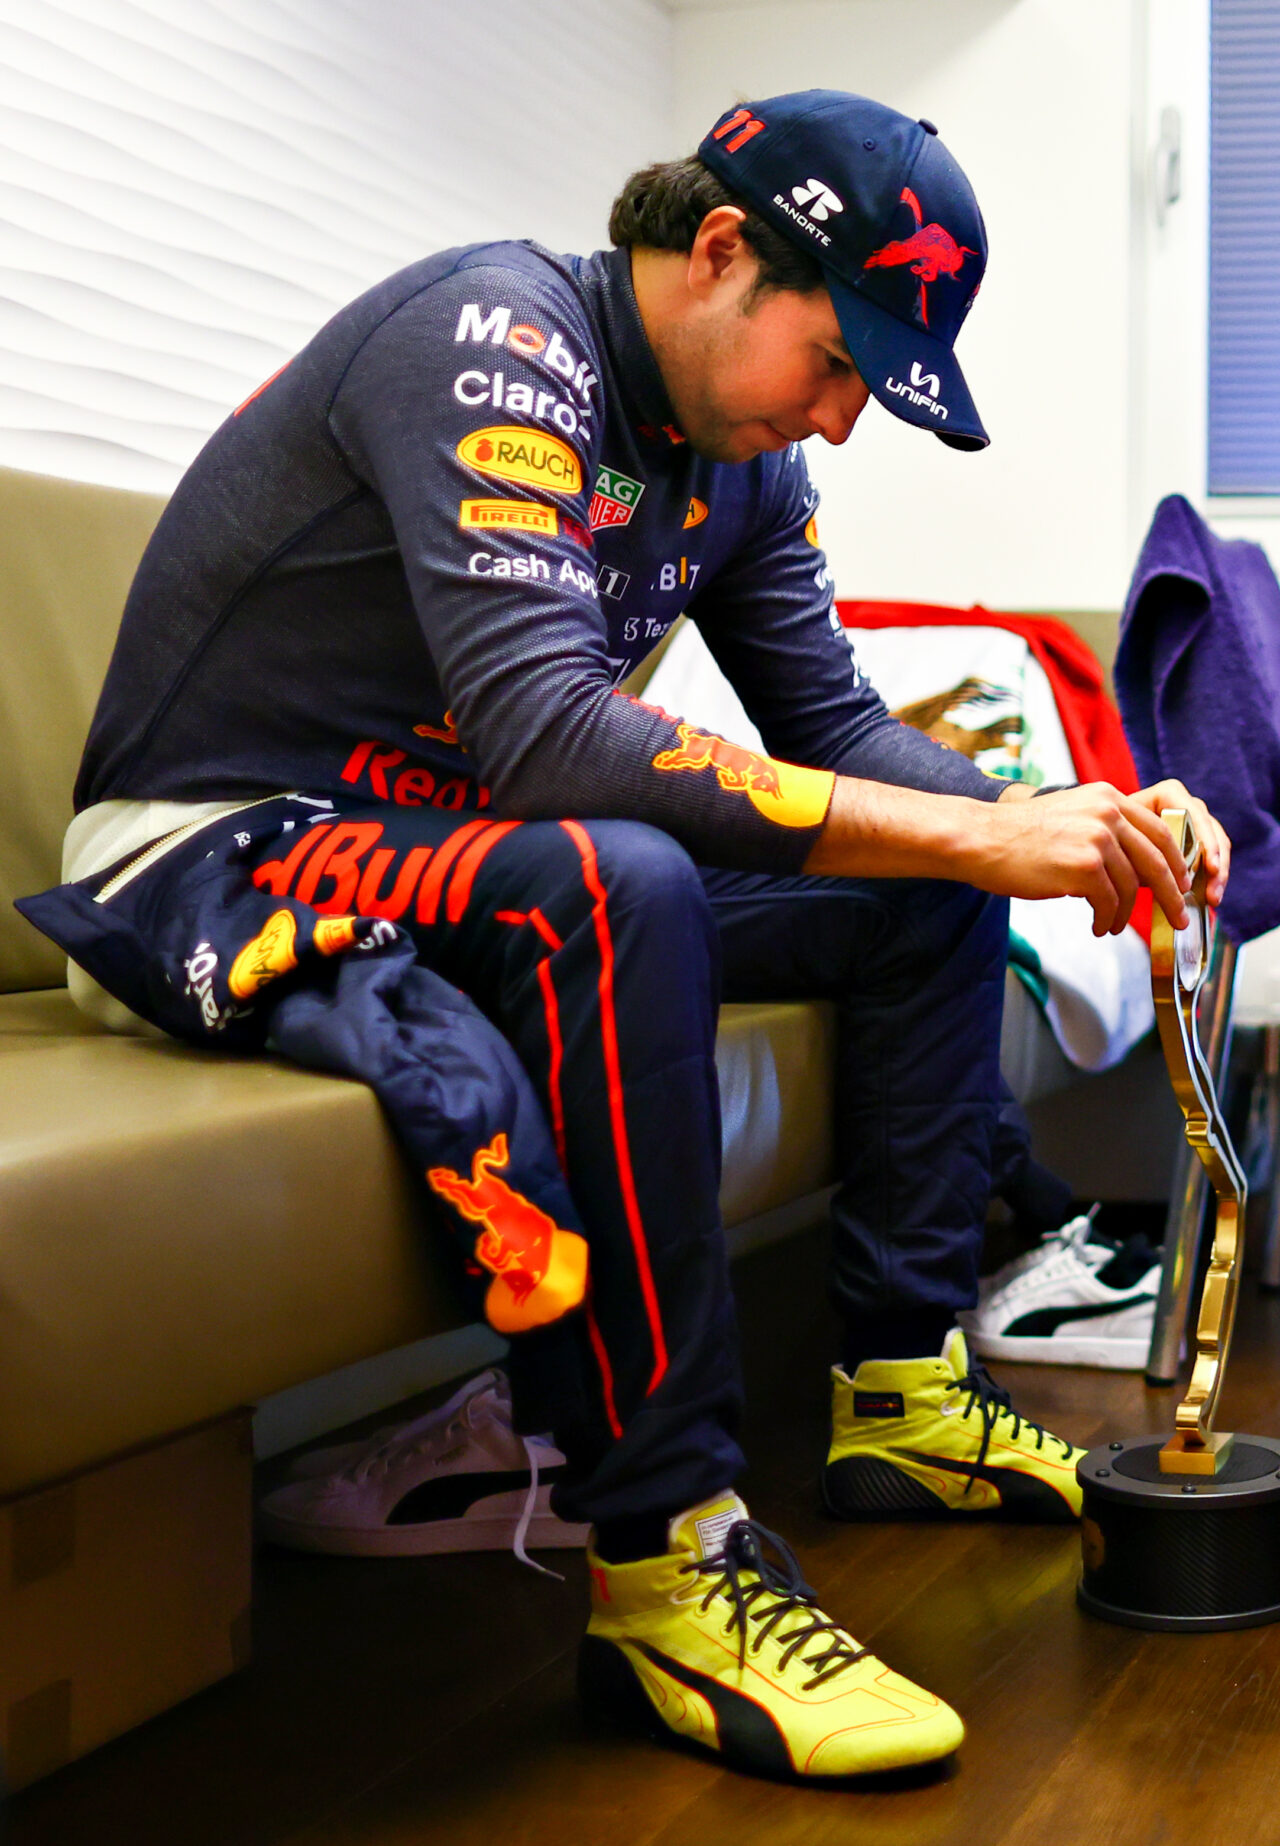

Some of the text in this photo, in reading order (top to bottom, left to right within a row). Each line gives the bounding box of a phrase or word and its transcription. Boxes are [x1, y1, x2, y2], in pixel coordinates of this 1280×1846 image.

[773, 193, 832, 248] BANORTE
[454, 370, 578, 434] Claro
[497, 441, 574, 484] RAUCH
[596, 471, 635, 503] AG
[470, 505, 549, 528] PIRELLI
[468, 552, 549, 579] Cash
